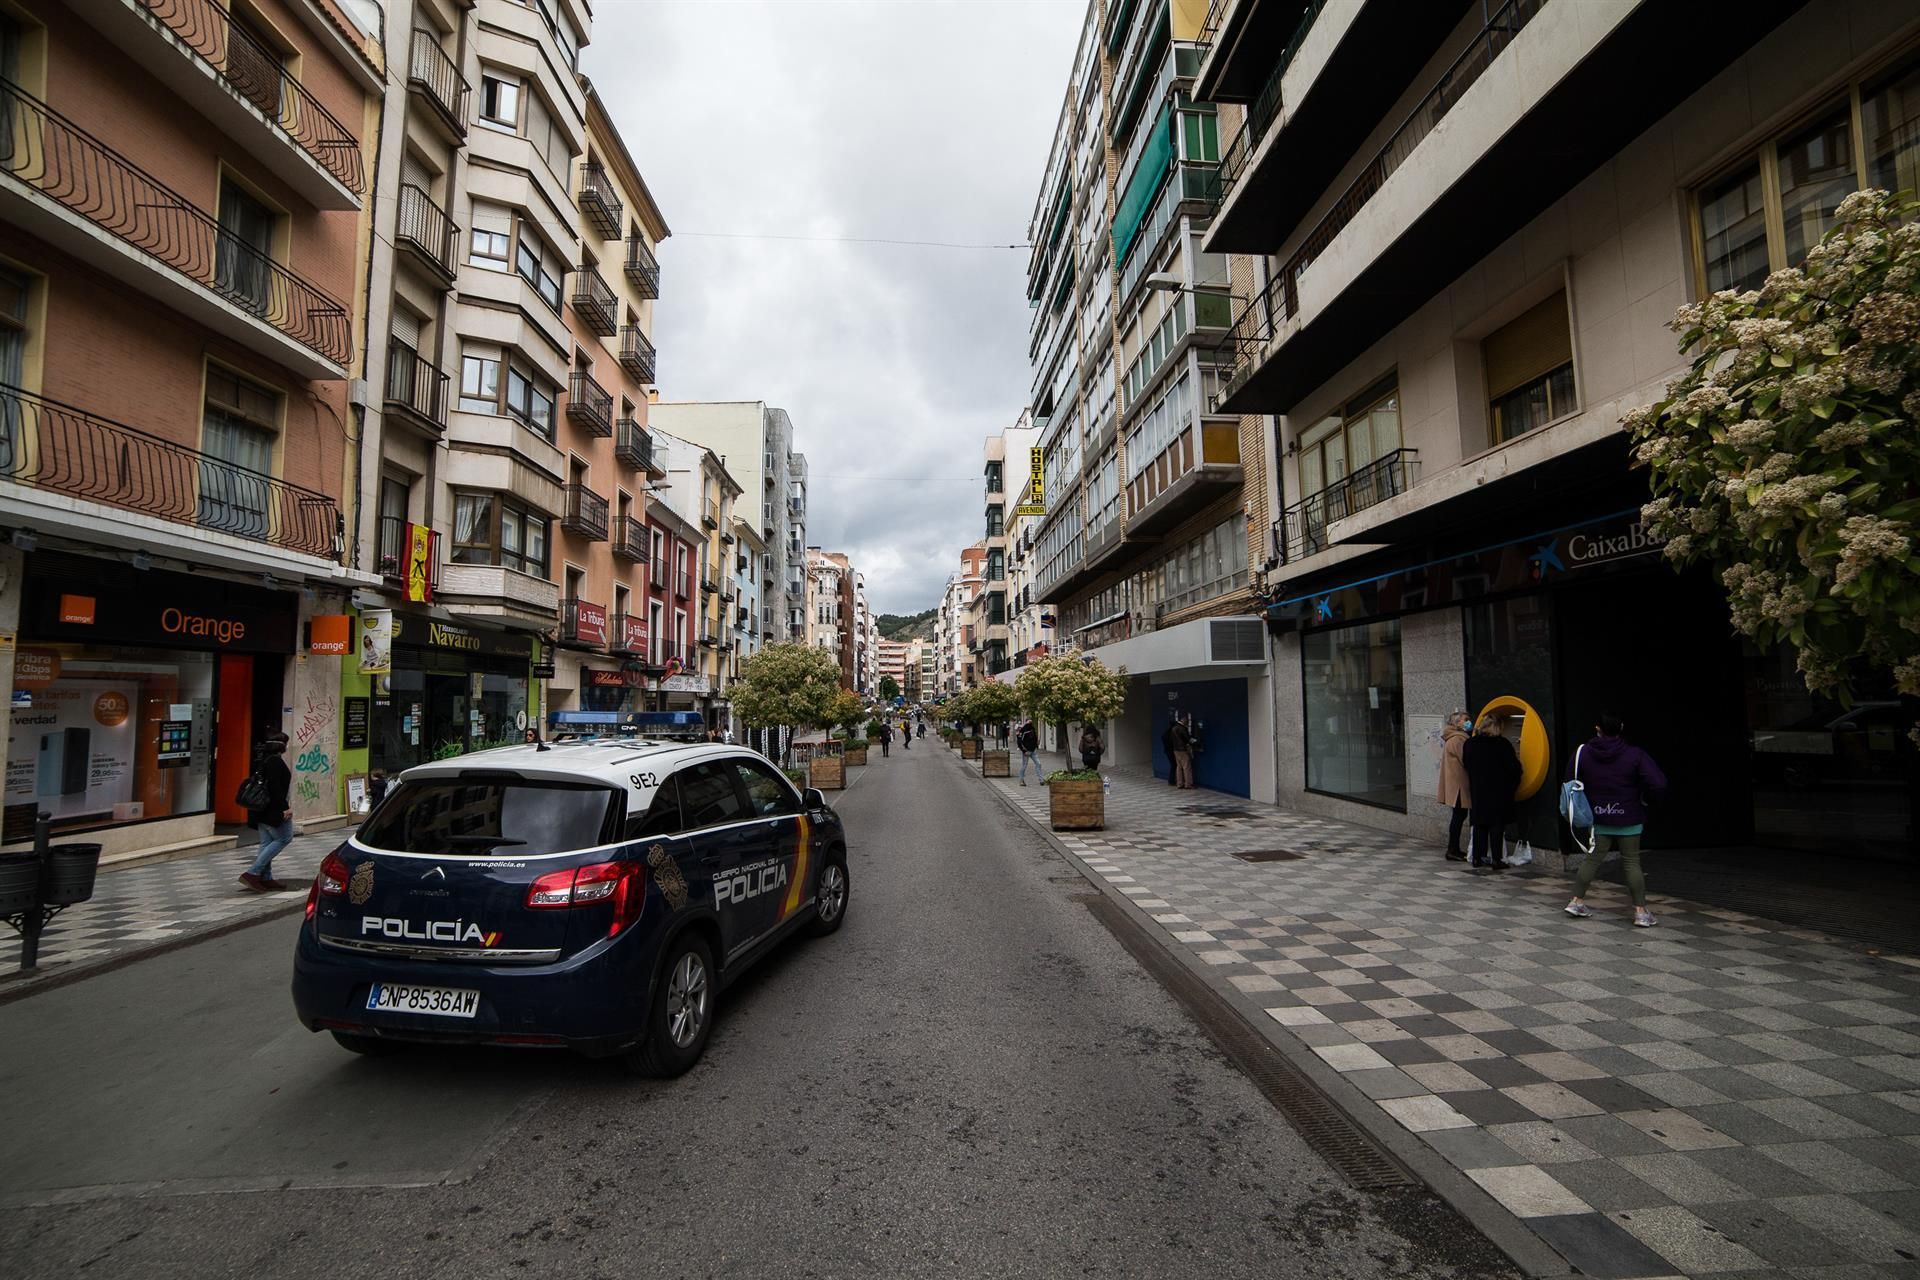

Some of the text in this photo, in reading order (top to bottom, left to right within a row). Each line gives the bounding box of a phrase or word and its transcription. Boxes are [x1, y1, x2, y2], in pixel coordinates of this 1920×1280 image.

[1032, 449, 1042, 493] HOSTAL
[1018, 506, 1045, 514] AVENIDA
[65, 614, 92, 623] orange
[161, 607, 245, 643] Orange
[579, 608, 605, 628] La Tribuna
[428, 622, 480, 650] Navarro
[628, 623, 647, 639] La Tribuna
[312, 641, 345, 652] orange
[15, 653, 52, 664] Fibra
[16, 664, 51, 674] 1Gbps
[14, 714, 57, 725] verdad
[630, 771, 660, 790] 9E2
[468, 860, 526, 869] www.policia.es
[712, 857, 775, 881] CUERPO NACIONAL DE
[361, 916, 485, 942] POLICÍA
[376, 985, 478, 1014] CNP8536AW
